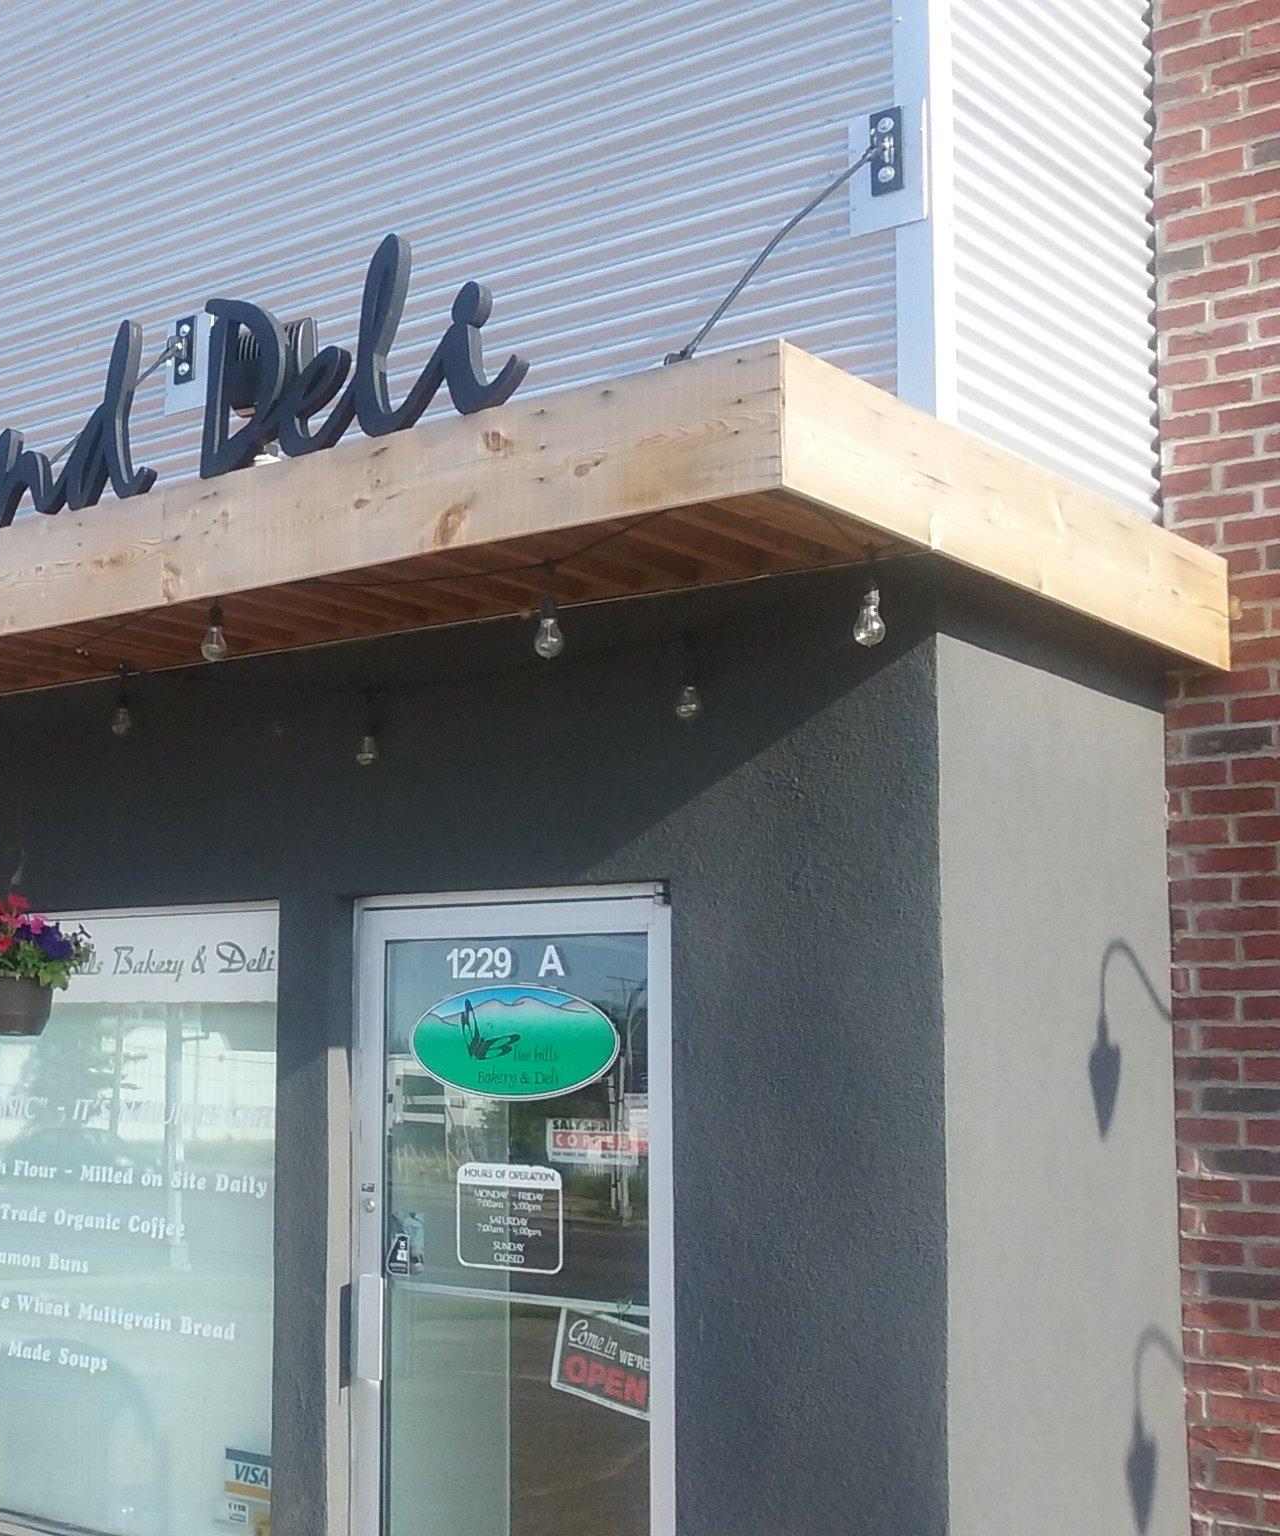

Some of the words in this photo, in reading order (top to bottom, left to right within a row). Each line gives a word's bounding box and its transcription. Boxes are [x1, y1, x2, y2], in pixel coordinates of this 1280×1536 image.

[199, 233, 531, 480] Deli
[113, 945, 185, 982] Bakery
[191, 945, 207, 975] &
[216, 941, 276, 973] Deli
[446, 946, 512, 979] 1229
[538, 944, 565, 977] A
[13, 1158, 57, 1178] Flour
[80, 1164, 134, 1186] Milled
[141, 1172, 163, 1187] on
[171, 1170, 207, 1191] Site
[215, 1174, 268, 1199] Daily
[464, 1168, 493, 1179] HOURS
[509, 1171, 556, 1182] OPERATION
[474, 1188, 509, 1199] MONDAY
[518, 1191, 545, 1201] FRIDAY
[0, 1203, 48, 1224] Trade
[54, 1208, 121, 1233] Organic
[128, 1214, 186, 1240] Coffee
[489, 1214, 529, 1227] SATURDAY
[47, 1252, 90, 1274] Buns
[492, 1240, 526, 1252] SUNDAY
[493, 1253, 526, 1264] CLOSED
[16, 1294, 71, 1318] Wheat
[78, 1301, 172, 1331] Multigrain
[179, 1315, 237, 1341] Bread
[7, 1339, 52, 1363] Made
[58, 1348, 109, 1373] Soups
[568, 1319, 605, 1350] Come
[605, 1335, 619, 1357] in
[619, 1349, 651, 1372] WE'RE
[563, 1354, 648, 1405] OPEN
[234, 1463, 270, 1488] VISA
